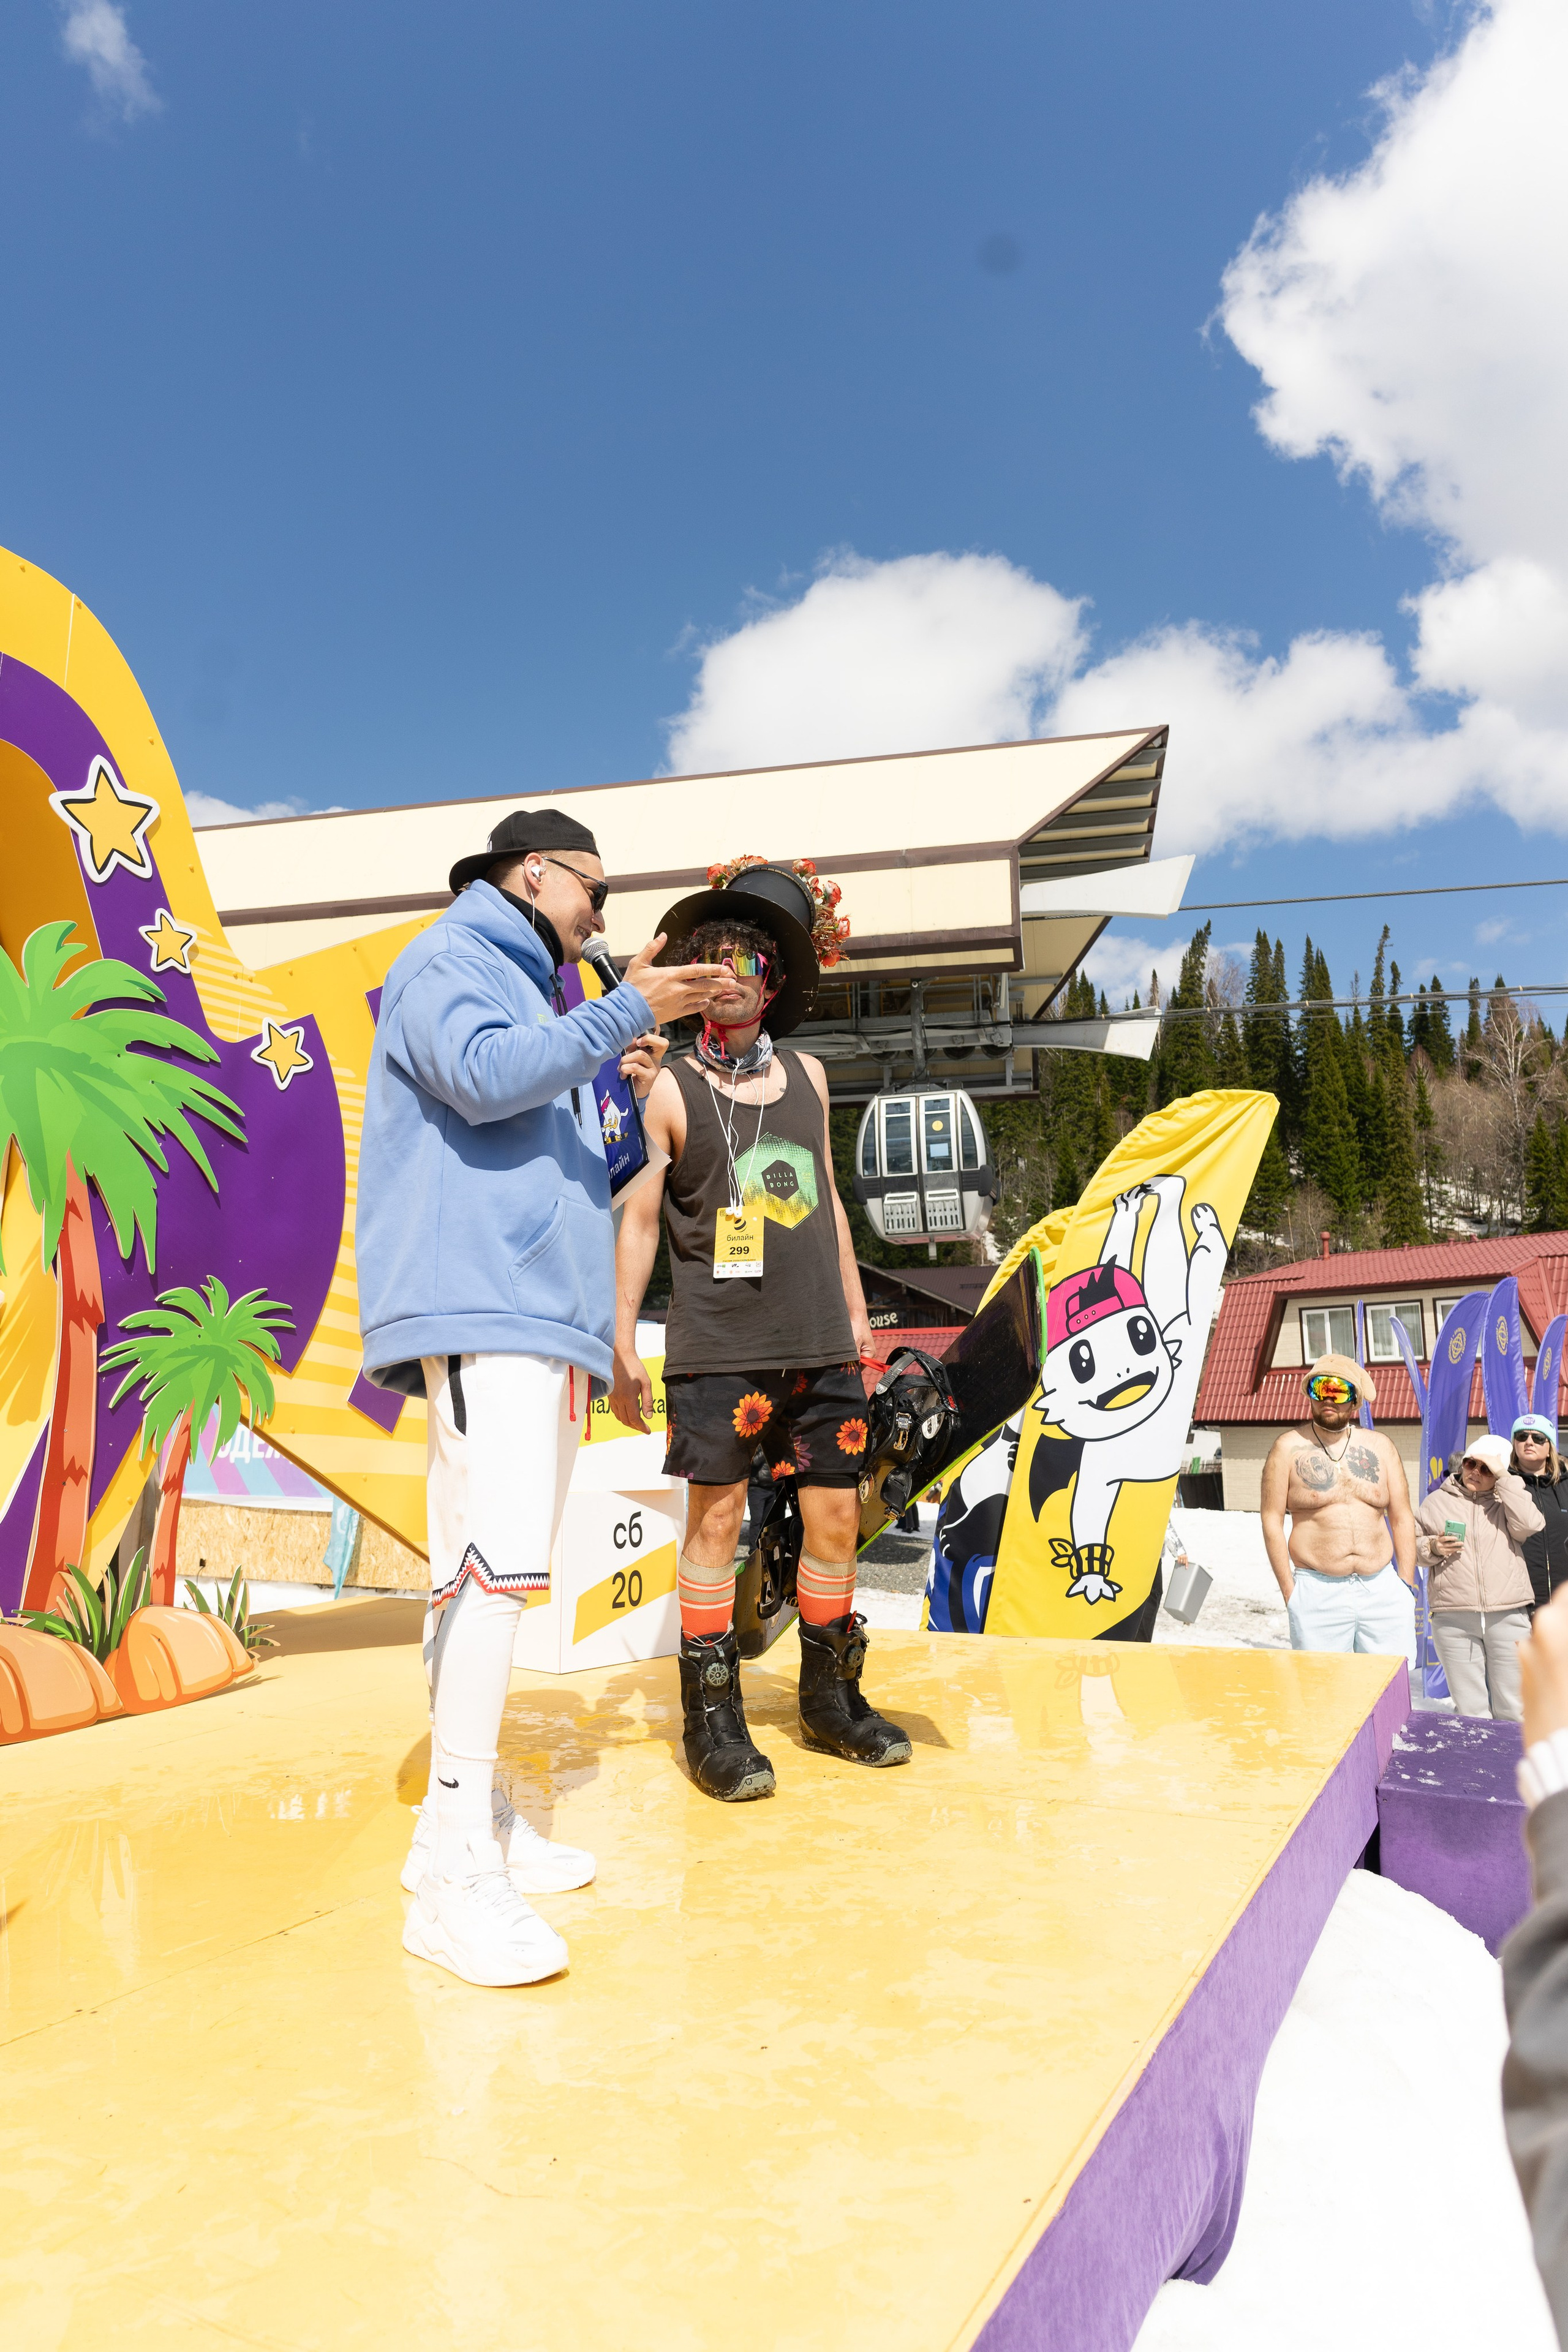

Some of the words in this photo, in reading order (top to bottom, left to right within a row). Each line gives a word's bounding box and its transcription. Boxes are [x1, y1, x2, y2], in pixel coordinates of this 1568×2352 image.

[608, 1153, 630, 1180] лайн
[729, 1246, 750, 1255] 299
[613, 1510, 643, 1550] сб
[612, 1570, 643, 1609] 20
